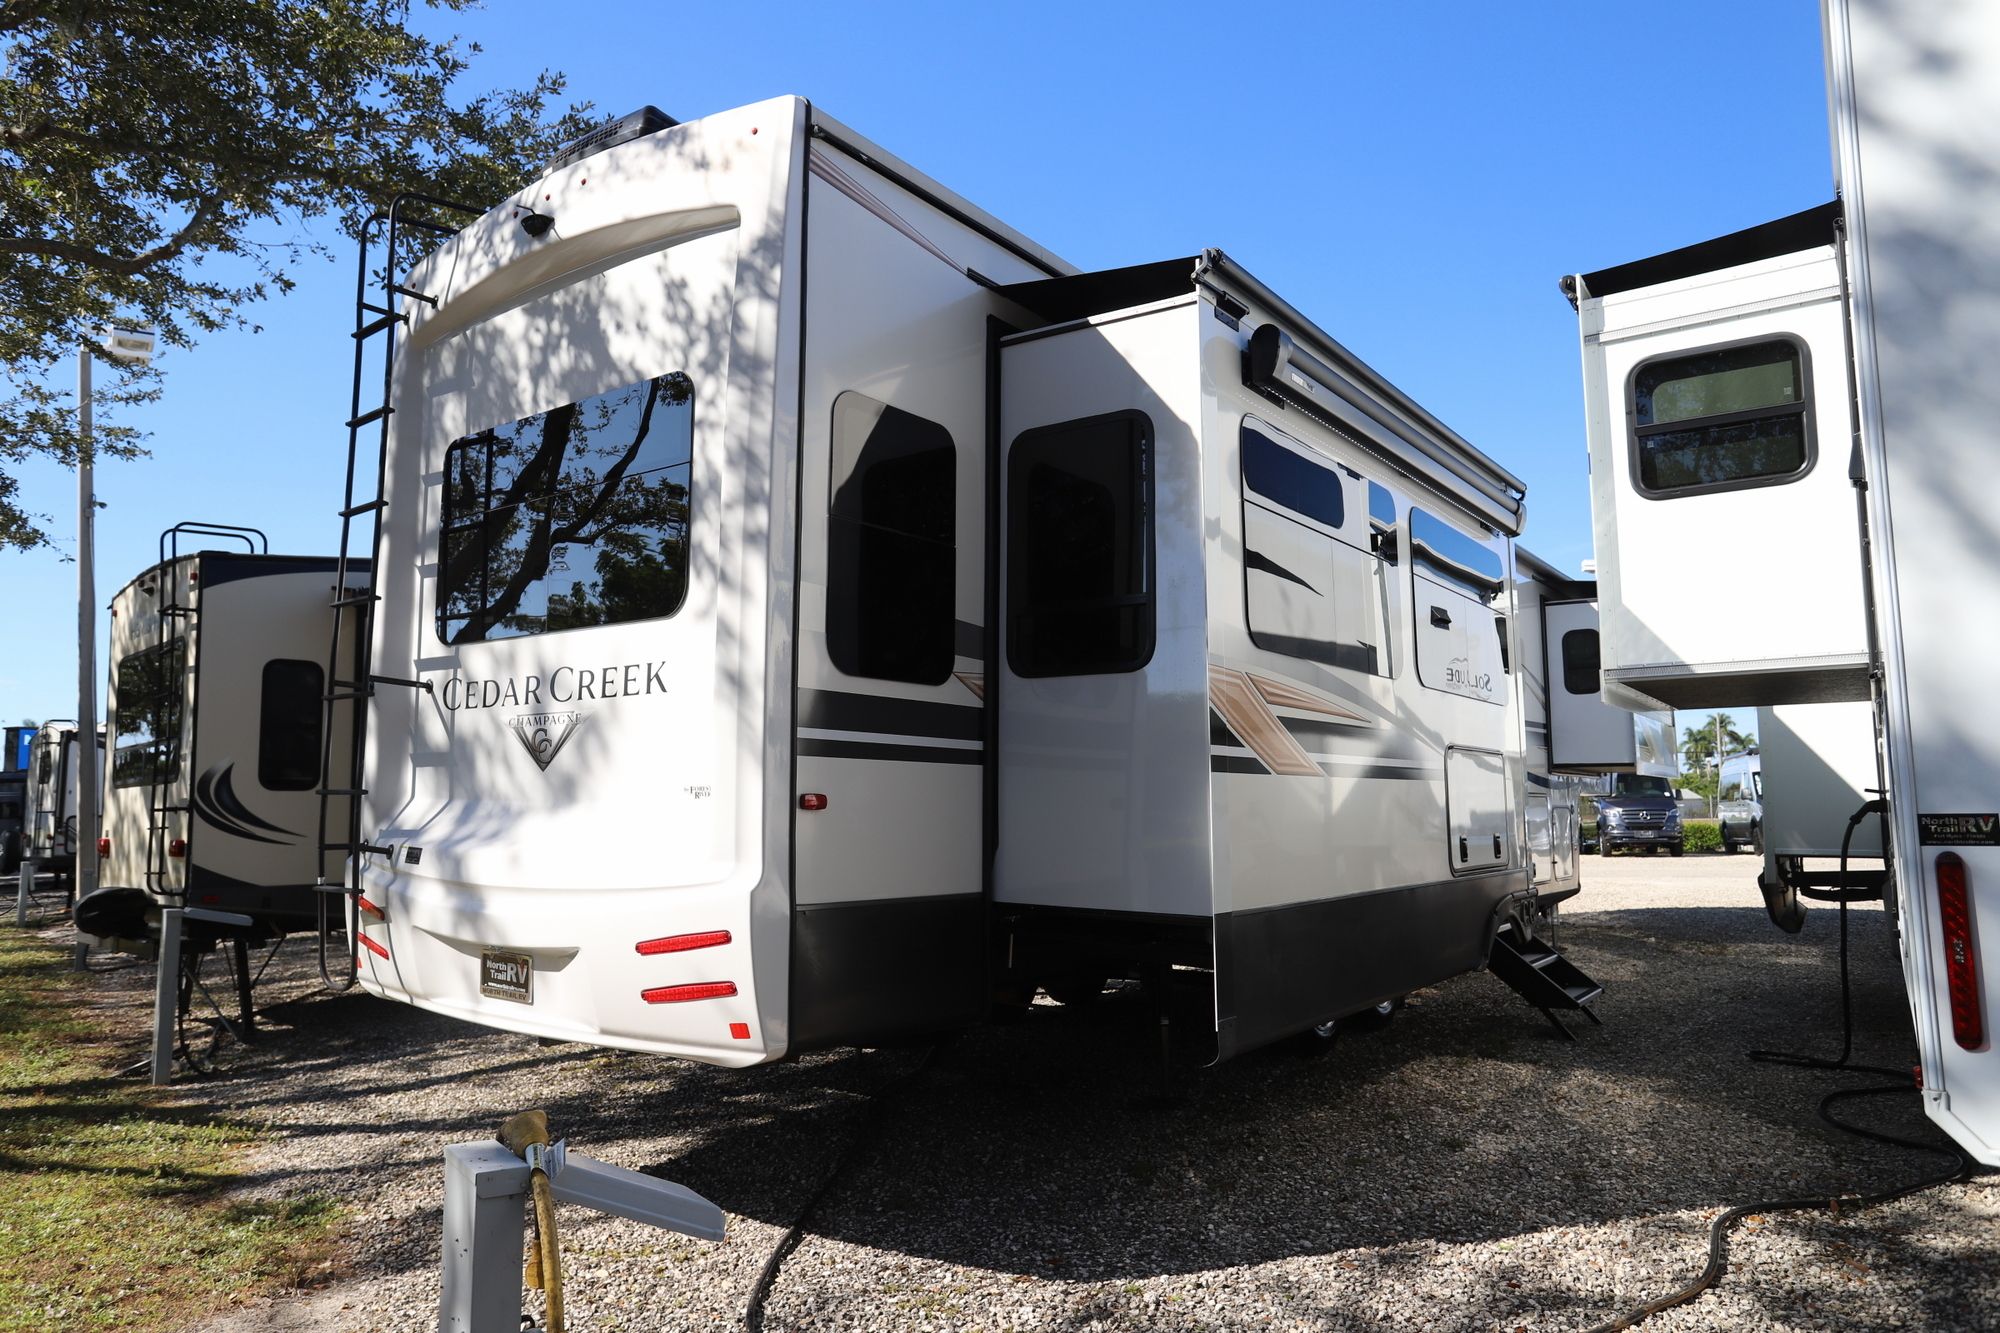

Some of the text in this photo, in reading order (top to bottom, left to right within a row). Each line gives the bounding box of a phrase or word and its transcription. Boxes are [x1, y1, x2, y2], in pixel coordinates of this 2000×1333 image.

[443, 660, 668, 711] CEDAR CREEK
[508, 713, 582, 727] CHAMPAGNE
[1921, 815, 1995, 833] North RV
[1928, 825, 1959, 833] Trail
[486, 959, 527, 984] North RV
[490, 970, 506, 980] Trail
